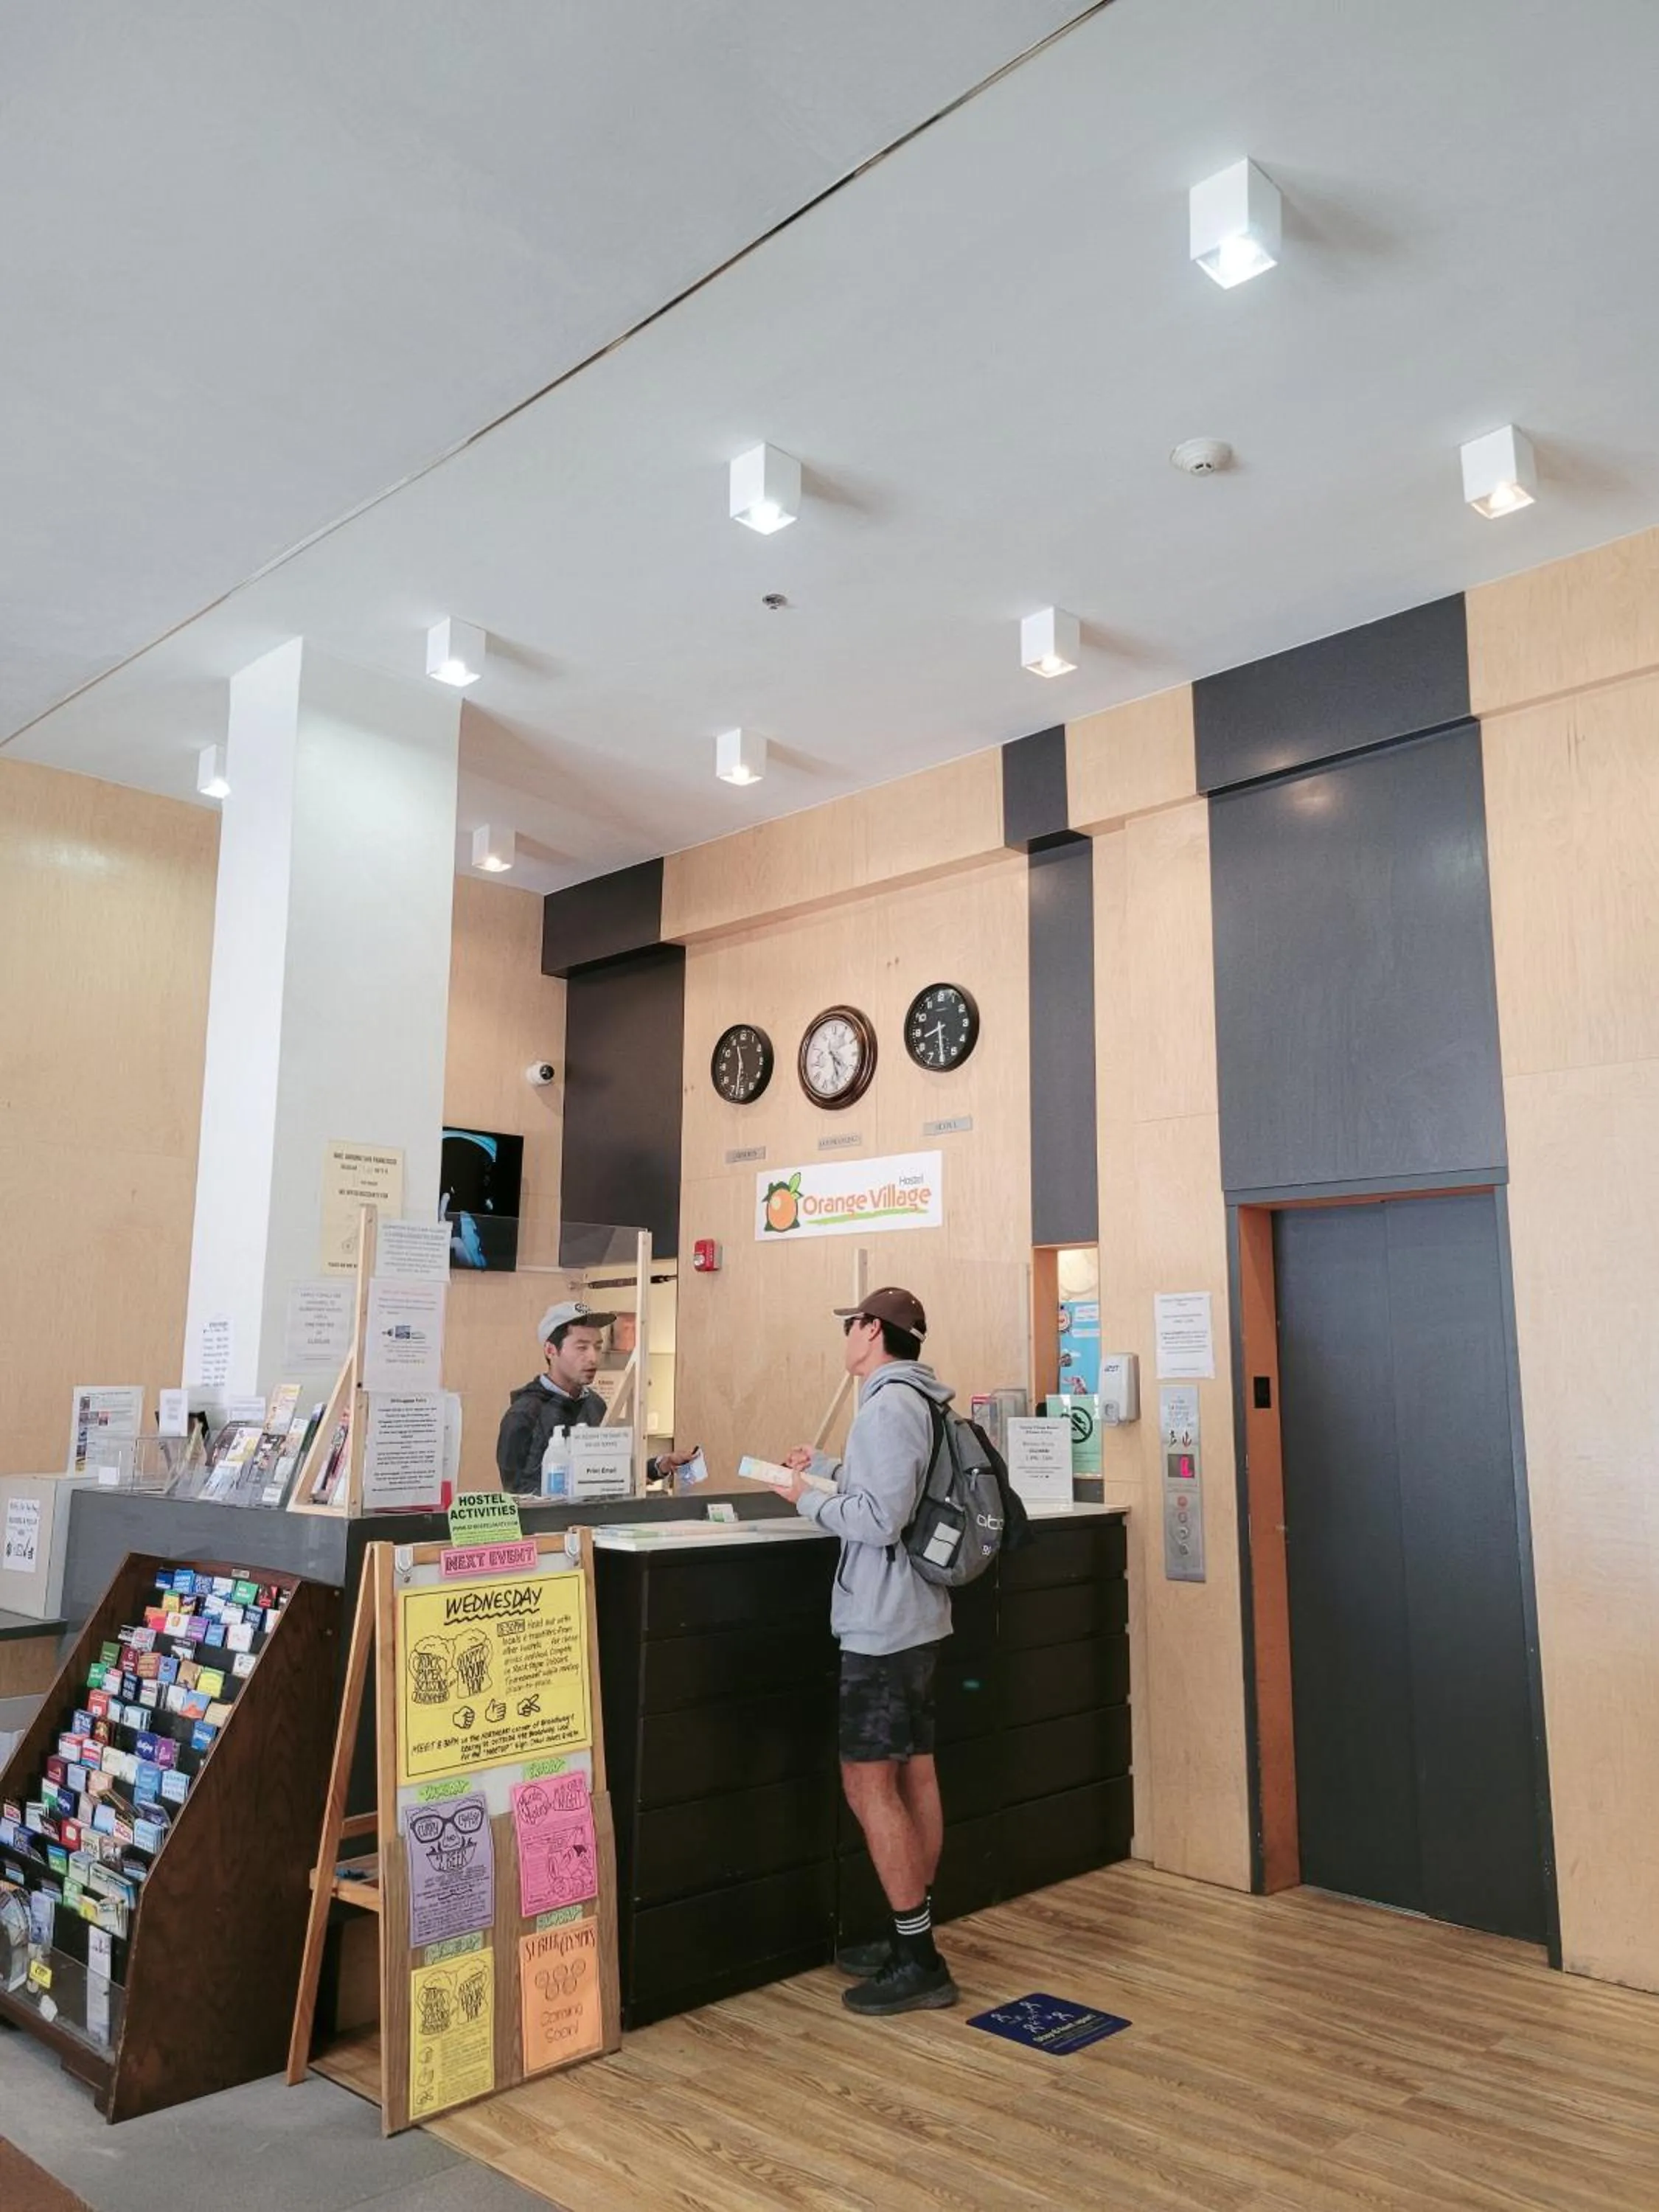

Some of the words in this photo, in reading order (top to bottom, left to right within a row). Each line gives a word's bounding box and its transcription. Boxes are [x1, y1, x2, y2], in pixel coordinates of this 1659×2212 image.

[803, 1193, 868, 1216] Orange
[869, 1184, 932, 1213] Village
[458, 1493, 507, 1506] HOSTEL
[450, 1505, 516, 1520] ACTIVITIES
[445, 1552, 486, 1571] NEXT
[489, 1546, 535, 1565] EVENT
[446, 1587, 543, 1616] WEDNESDAY
